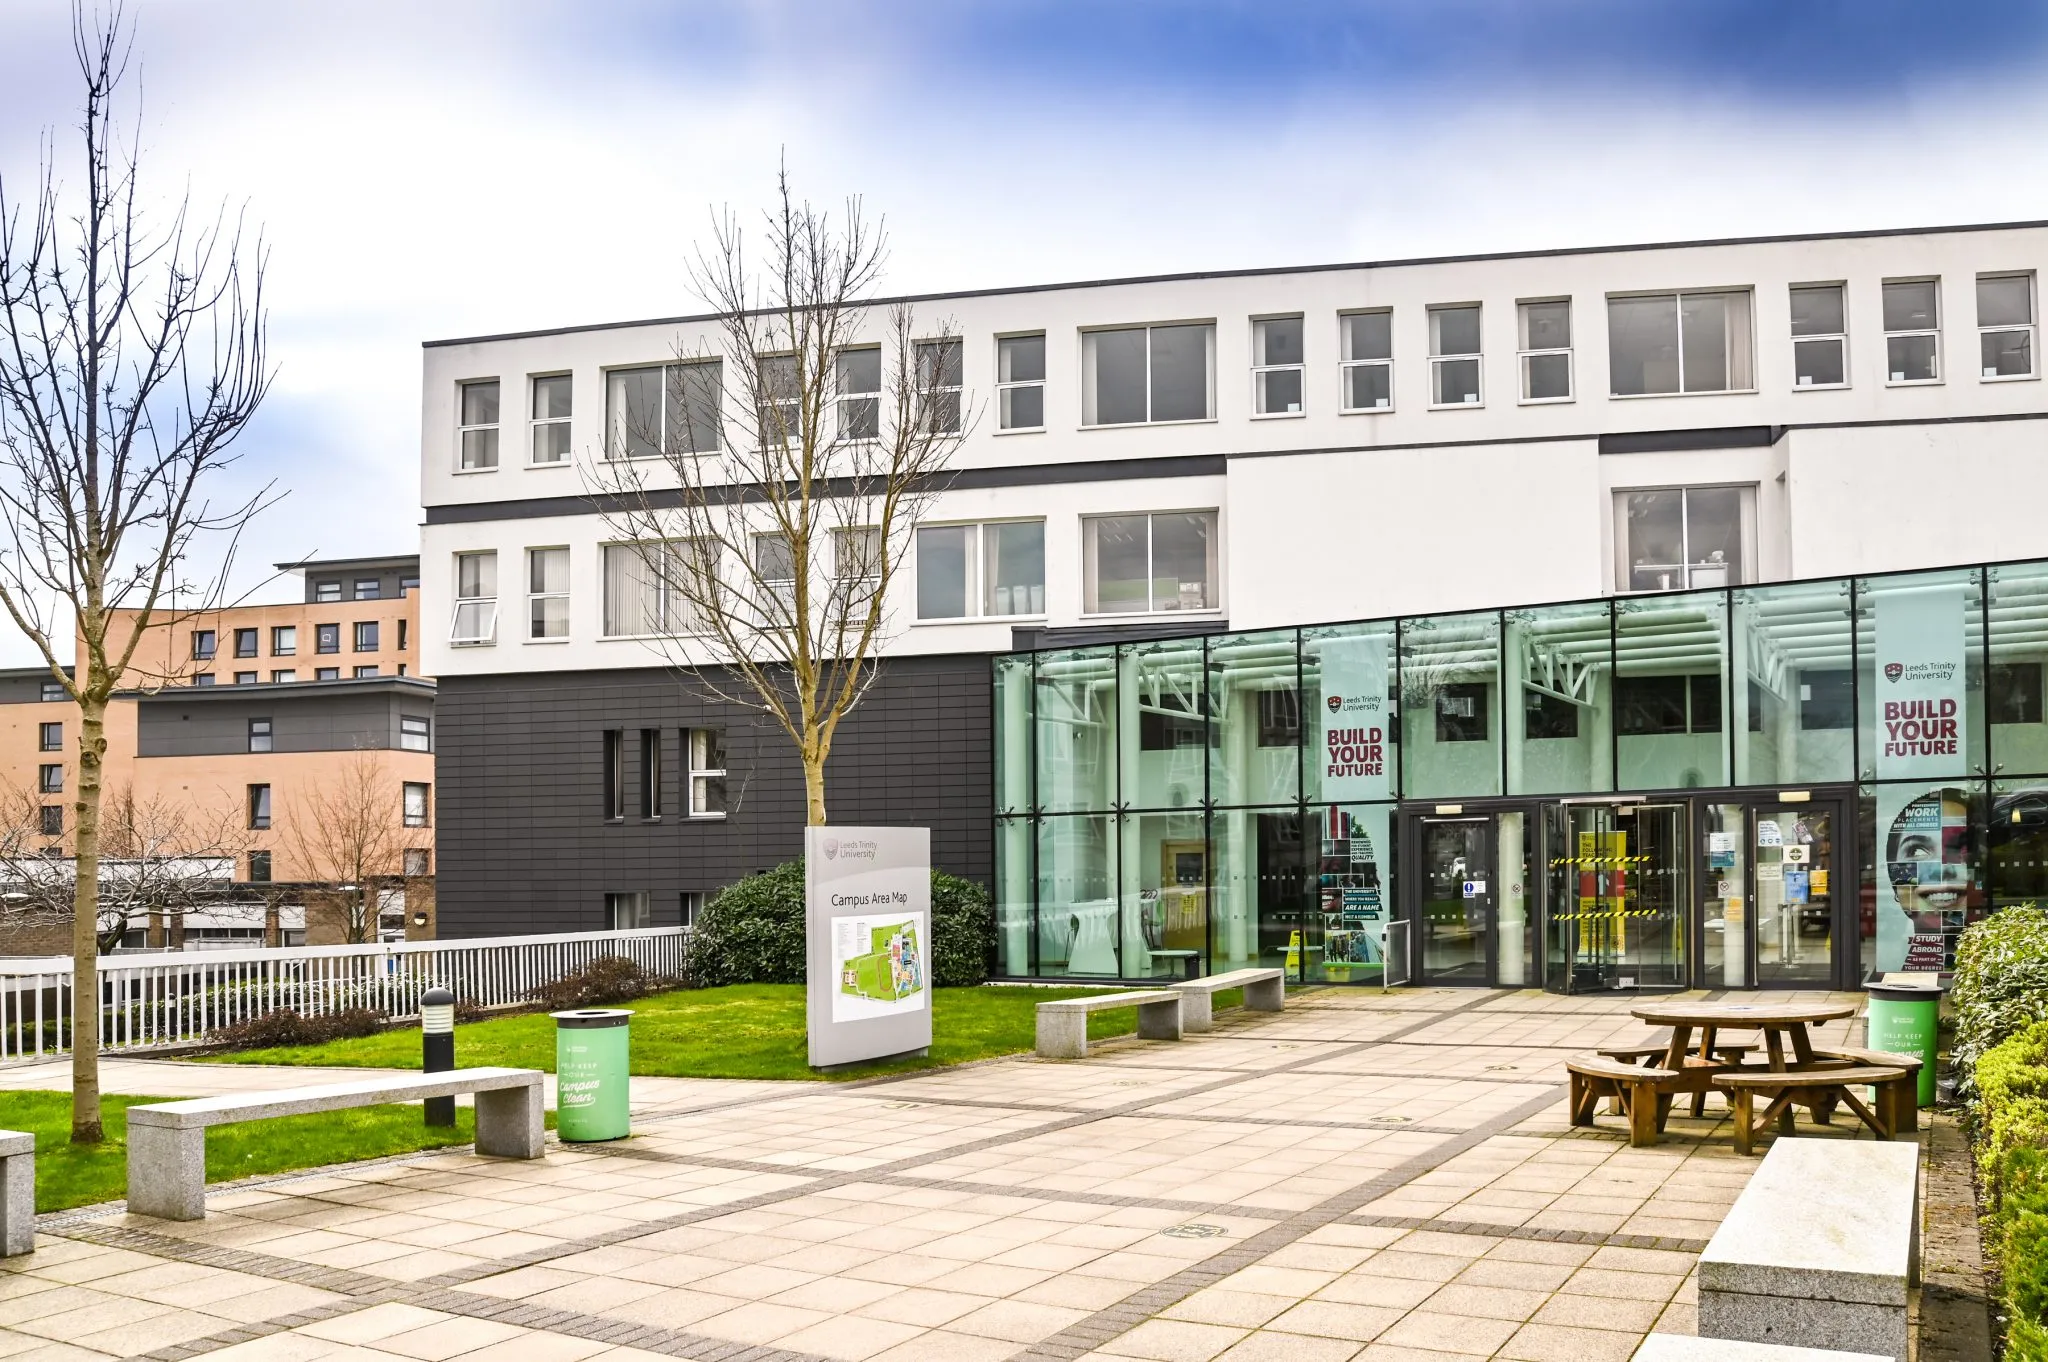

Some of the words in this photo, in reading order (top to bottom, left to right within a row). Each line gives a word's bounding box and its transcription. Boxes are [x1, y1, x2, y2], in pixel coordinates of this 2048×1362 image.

[1905, 664, 1928, 672] Leeds
[1930, 662, 1956, 670] Trinity
[1905, 671, 1953, 681] University
[1343, 703, 1379, 711] University
[1884, 698, 1957, 720] BUILD
[1327, 727, 1382, 746] BUILD
[1885, 719, 1958, 741] YOUR
[1328, 745, 1383, 763] YOUR
[1885, 739, 1957, 757] FUTURE
[1327, 763, 1383, 777] FUTURE
[1905, 808, 1939, 817] WORK
[840, 841, 858, 849] Leeds
[859, 840, 878, 850] Trinity
[840, 849, 876, 860] University
[831, 893, 870, 908] Campus
[871, 892, 890, 904] Area
[892, 891, 908, 906] Map
[1915, 935, 1942, 943] STUDY
[560, 1079, 600, 1093] Campus
[562, 1092, 595, 1105] Clean
